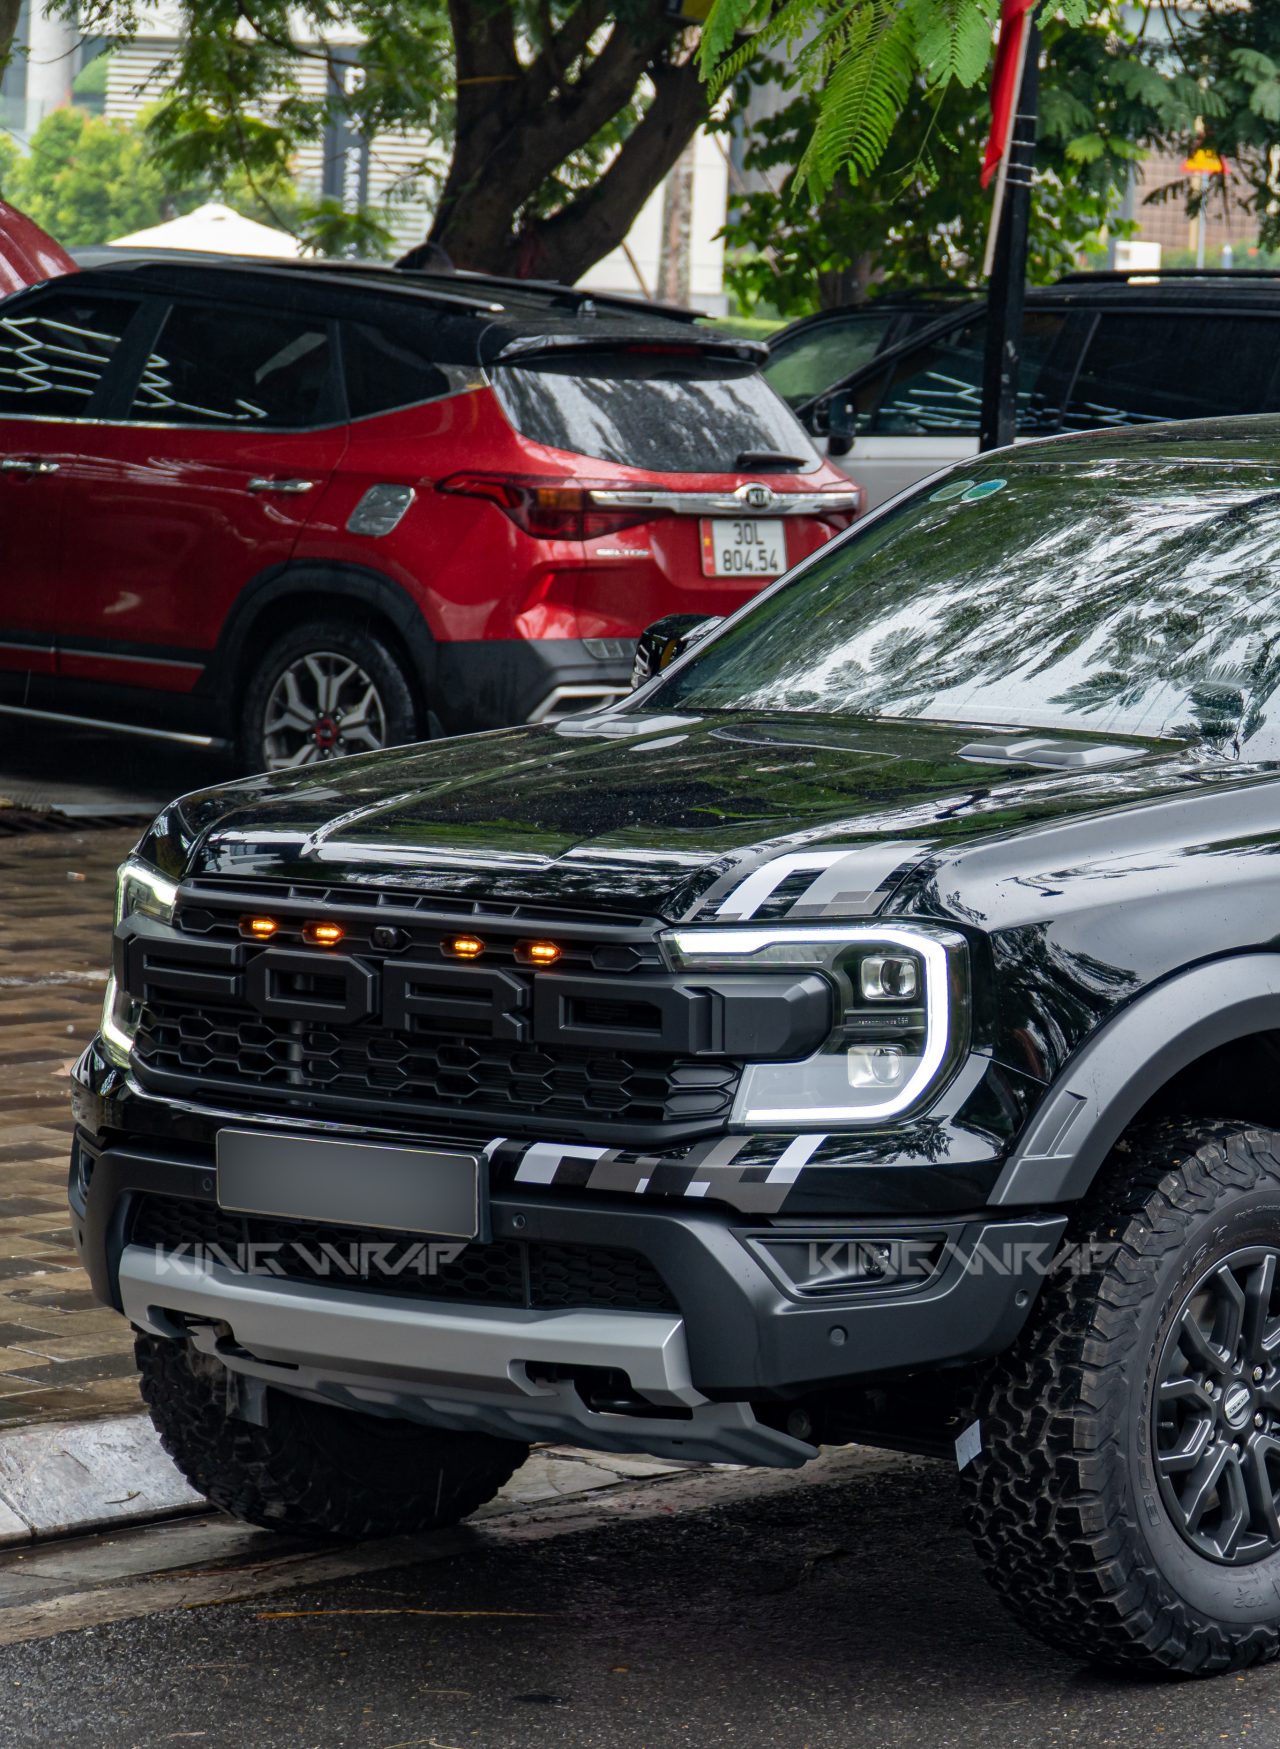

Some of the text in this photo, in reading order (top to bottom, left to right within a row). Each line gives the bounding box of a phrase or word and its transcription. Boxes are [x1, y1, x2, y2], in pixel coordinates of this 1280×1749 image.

[733, 523, 765, 545] 30L
[723, 550, 778, 571] 804.54
[116, 932, 702, 1054] FORD
